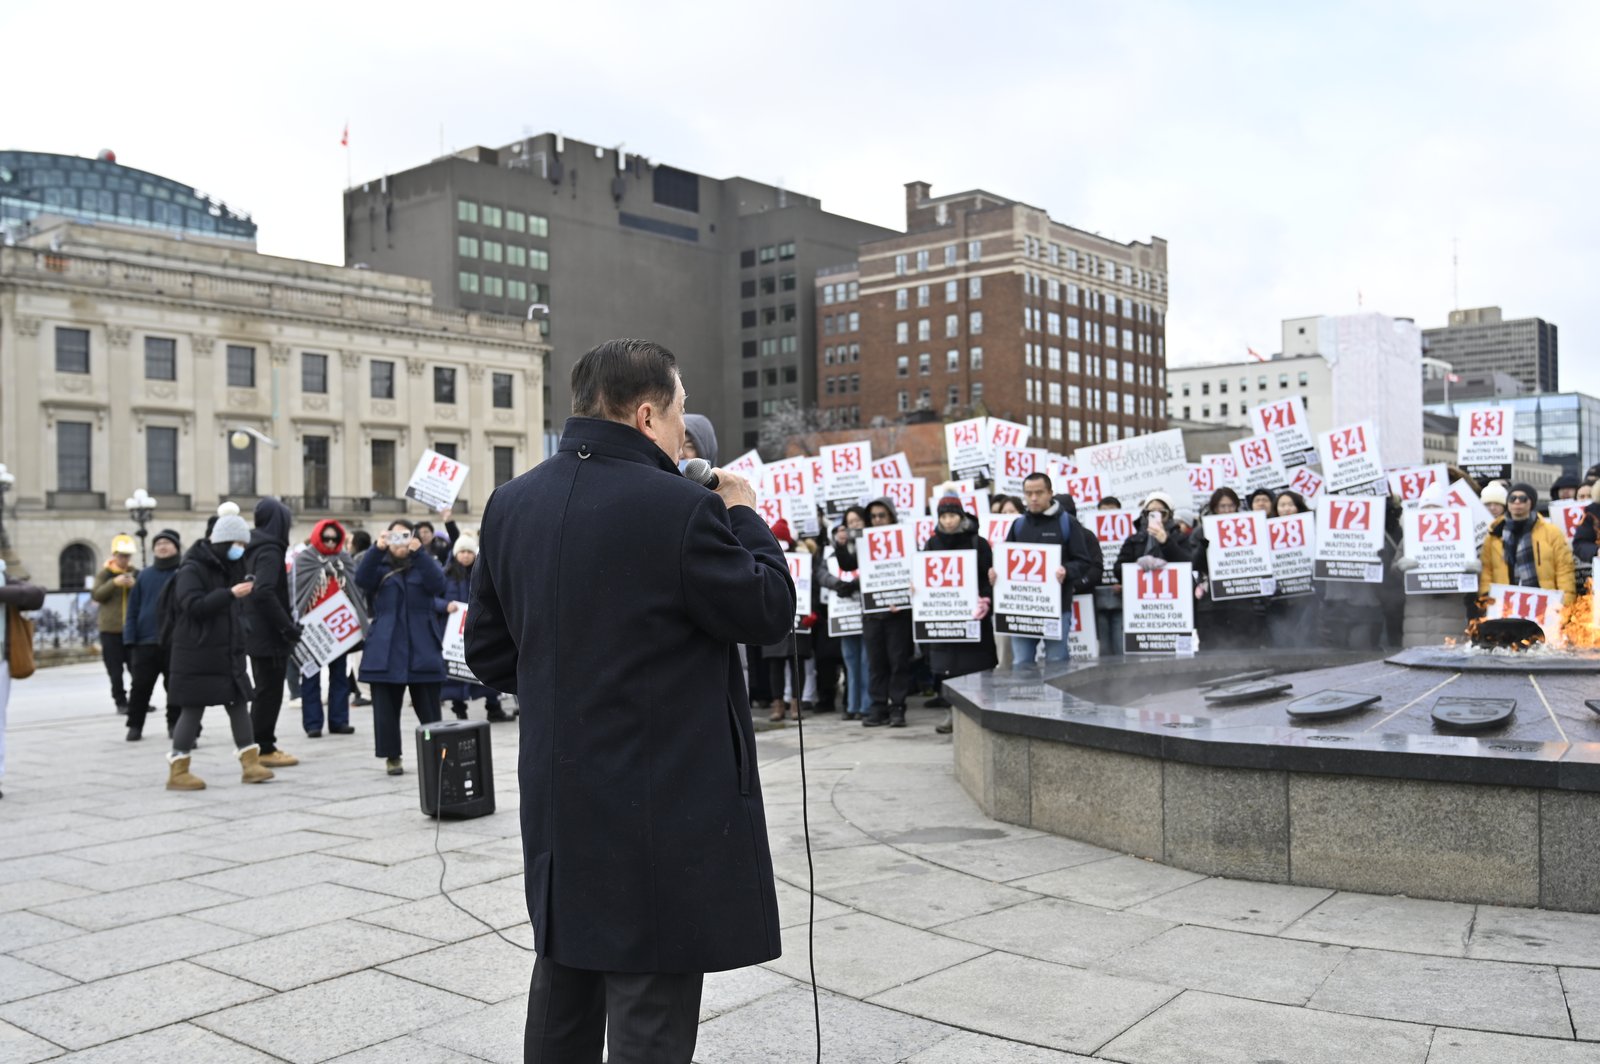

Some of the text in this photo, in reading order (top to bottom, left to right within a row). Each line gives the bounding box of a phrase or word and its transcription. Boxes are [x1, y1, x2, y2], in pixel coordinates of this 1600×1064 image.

[1263, 403, 1295, 431] 27
[1472, 411, 1501, 436] 33
[1242, 440, 1271, 467] 63
[1330, 427, 1366, 459] 34
[832, 447, 861, 473] 53
[1006, 452, 1035, 478] 39
[774, 472, 803, 495] 15
[883, 483, 914, 508] 68
[1068, 477, 1101, 503] 34
[1292, 469, 1321, 497] 25
[1096, 514, 1132, 541] 40
[1330, 501, 1369, 530] 72
[1419, 513, 1460, 541] 23
[868, 530, 904, 560] 31
[1217, 518, 1256, 547] 33
[1269, 520, 1305, 549] 28
[1007, 549, 1046, 582] 22
[1275, 551, 1303, 559] MONTHS
[926, 557, 963, 587] 34
[1231, 565, 1267, 574] RESPONSE
[1003, 593, 1033, 602] WAITING
[1011, 585, 1042, 593] MONTHS
[1138, 569, 1178, 599] 11
[935, 609, 972, 617] RESPONSE
[1016, 603, 1054, 613] RESPONSE
[1504, 591, 1547, 622] 11
[323, 604, 361, 643] 65
[1147, 621, 1187, 629] RESPONSE
